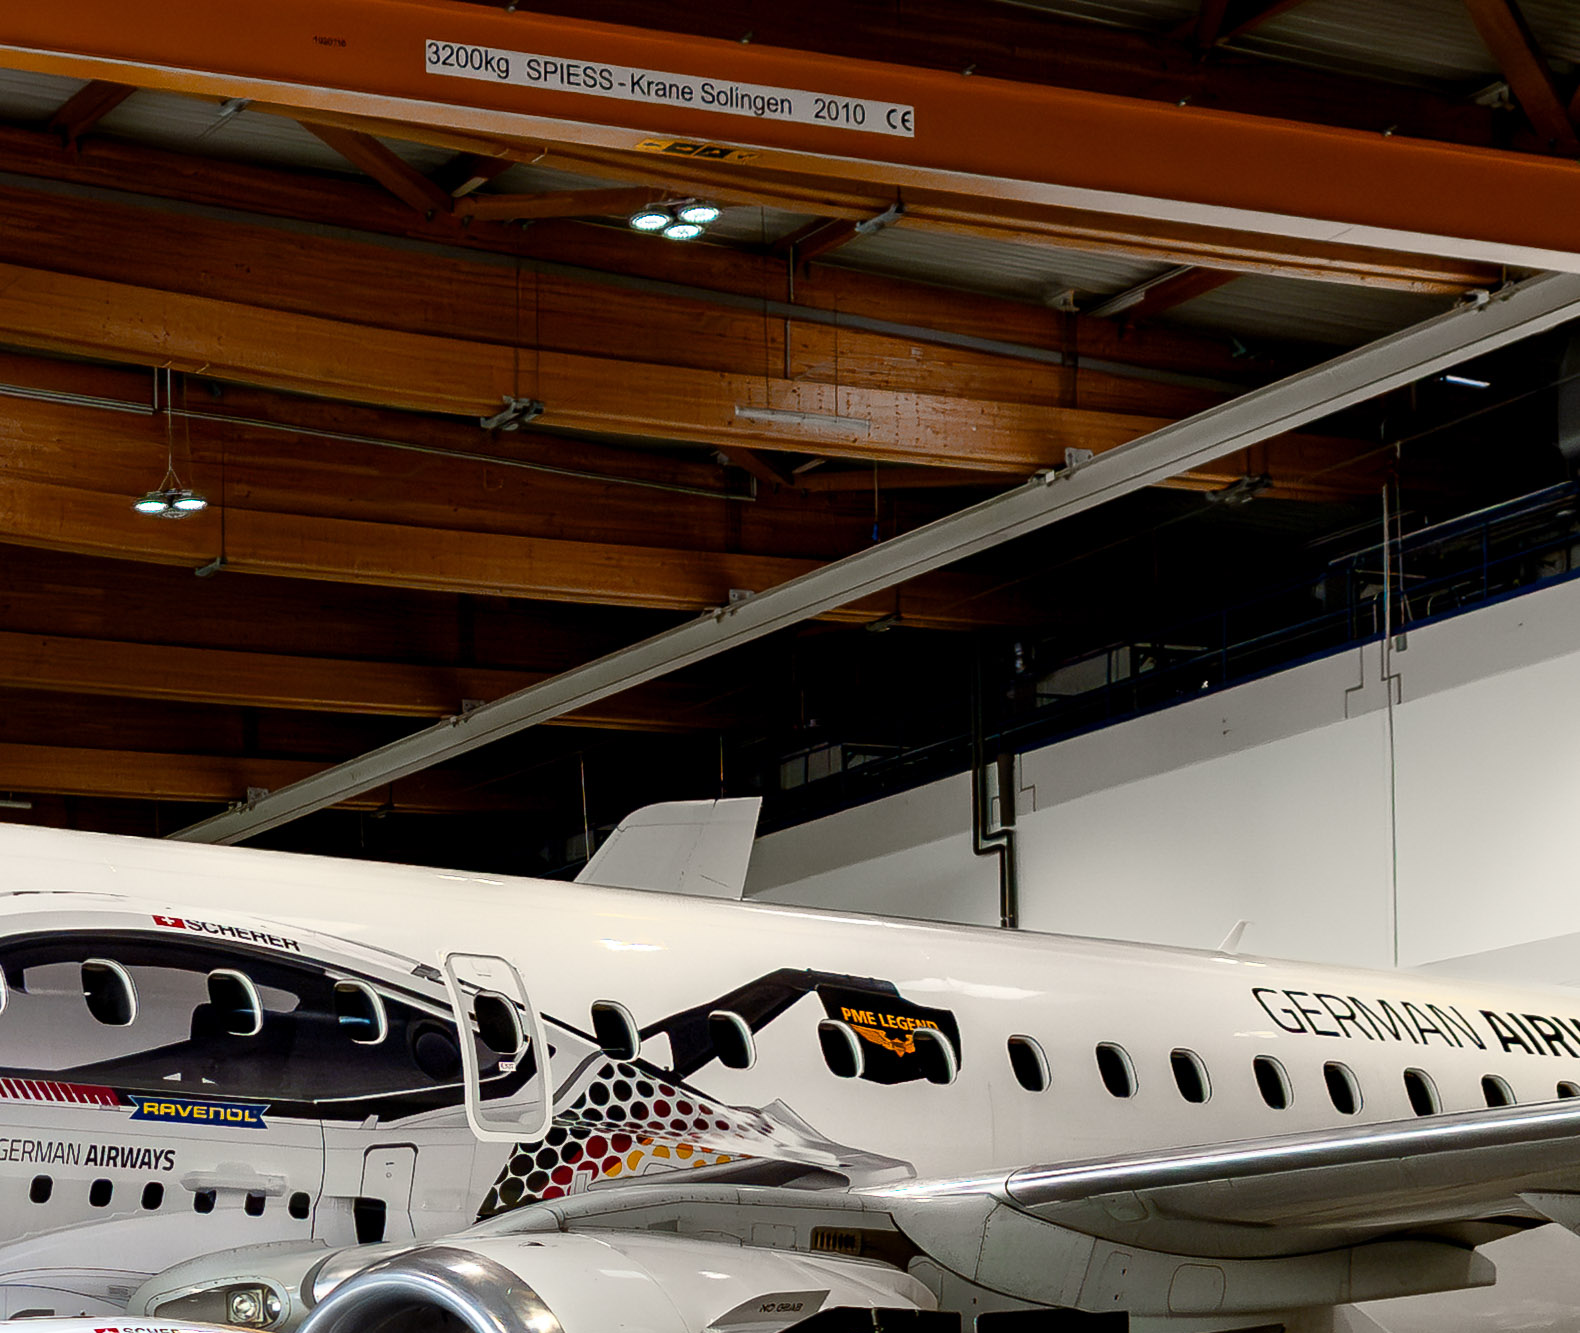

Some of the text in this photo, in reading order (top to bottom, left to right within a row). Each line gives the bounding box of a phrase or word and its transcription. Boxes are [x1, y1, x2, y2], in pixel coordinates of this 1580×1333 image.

[427, 42, 510, 79] 3200kg
[701, 82, 793, 115] Solingen
[814, 98, 866, 126] 2010
[841, 1007, 877, 1026] PME
[1252, 987, 1488, 1050] GERMAN
[143, 1102, 257, 1122] RAVENOL
[85, 1145, 175, 1171] AIRWAYS
[759, 1304, 776, 1313] NO
